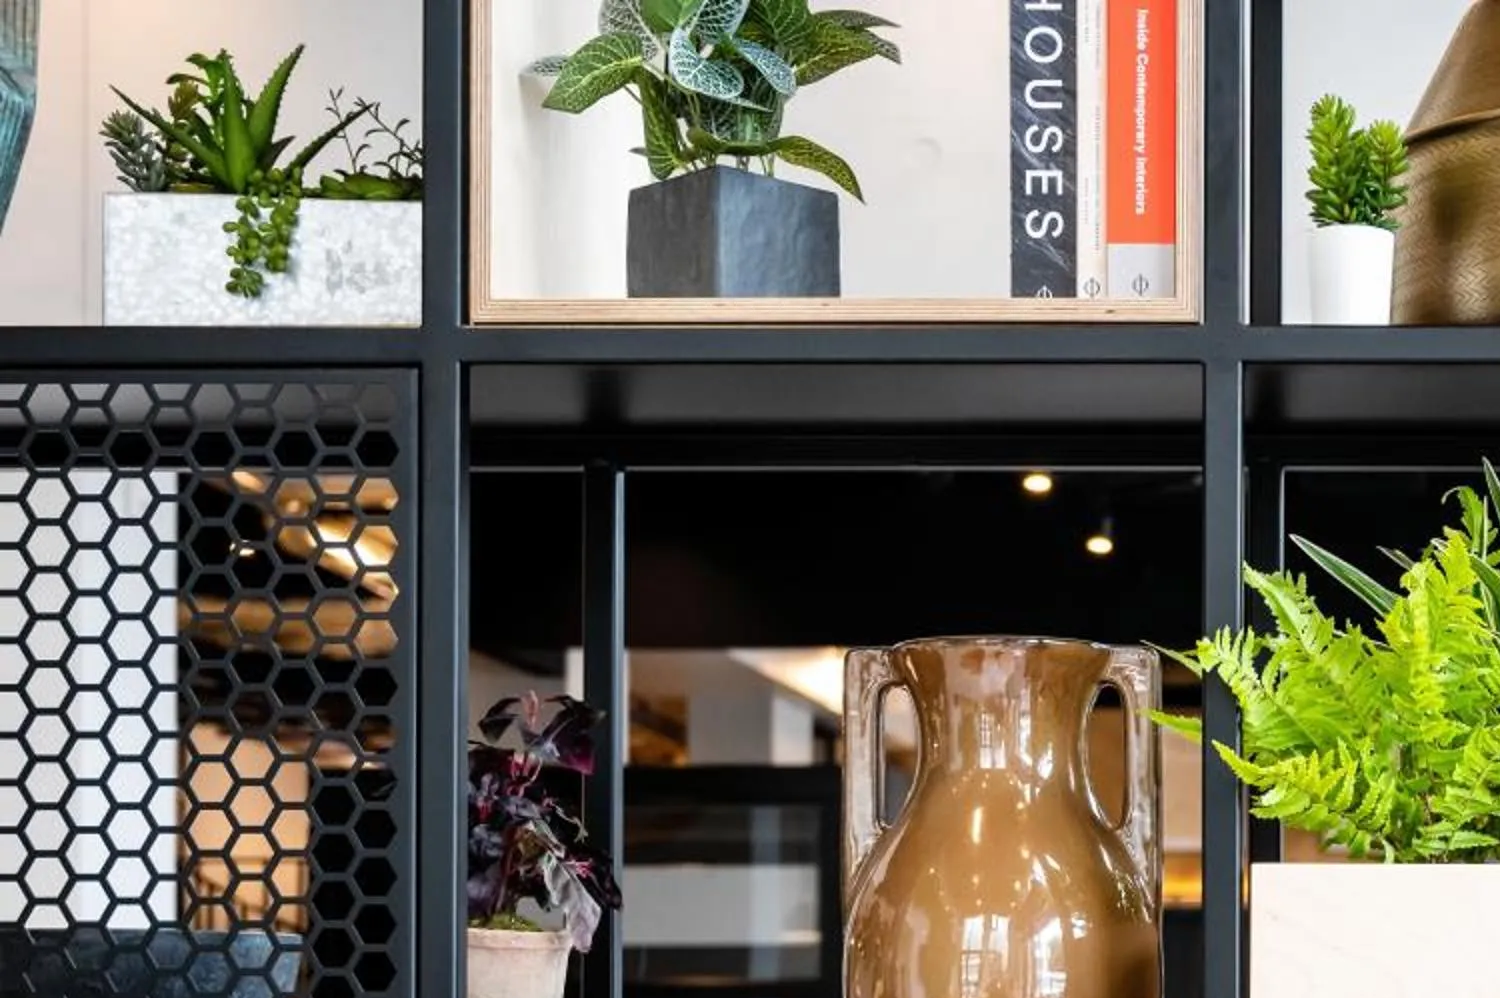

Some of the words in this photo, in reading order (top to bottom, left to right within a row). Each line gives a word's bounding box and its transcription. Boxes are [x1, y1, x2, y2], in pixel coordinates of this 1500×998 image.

[1135, 9, 1150, 50] Inside
[1133, 53, 1149, 154] Contemporary
[1135, 157, 1148, 215] Interiors
